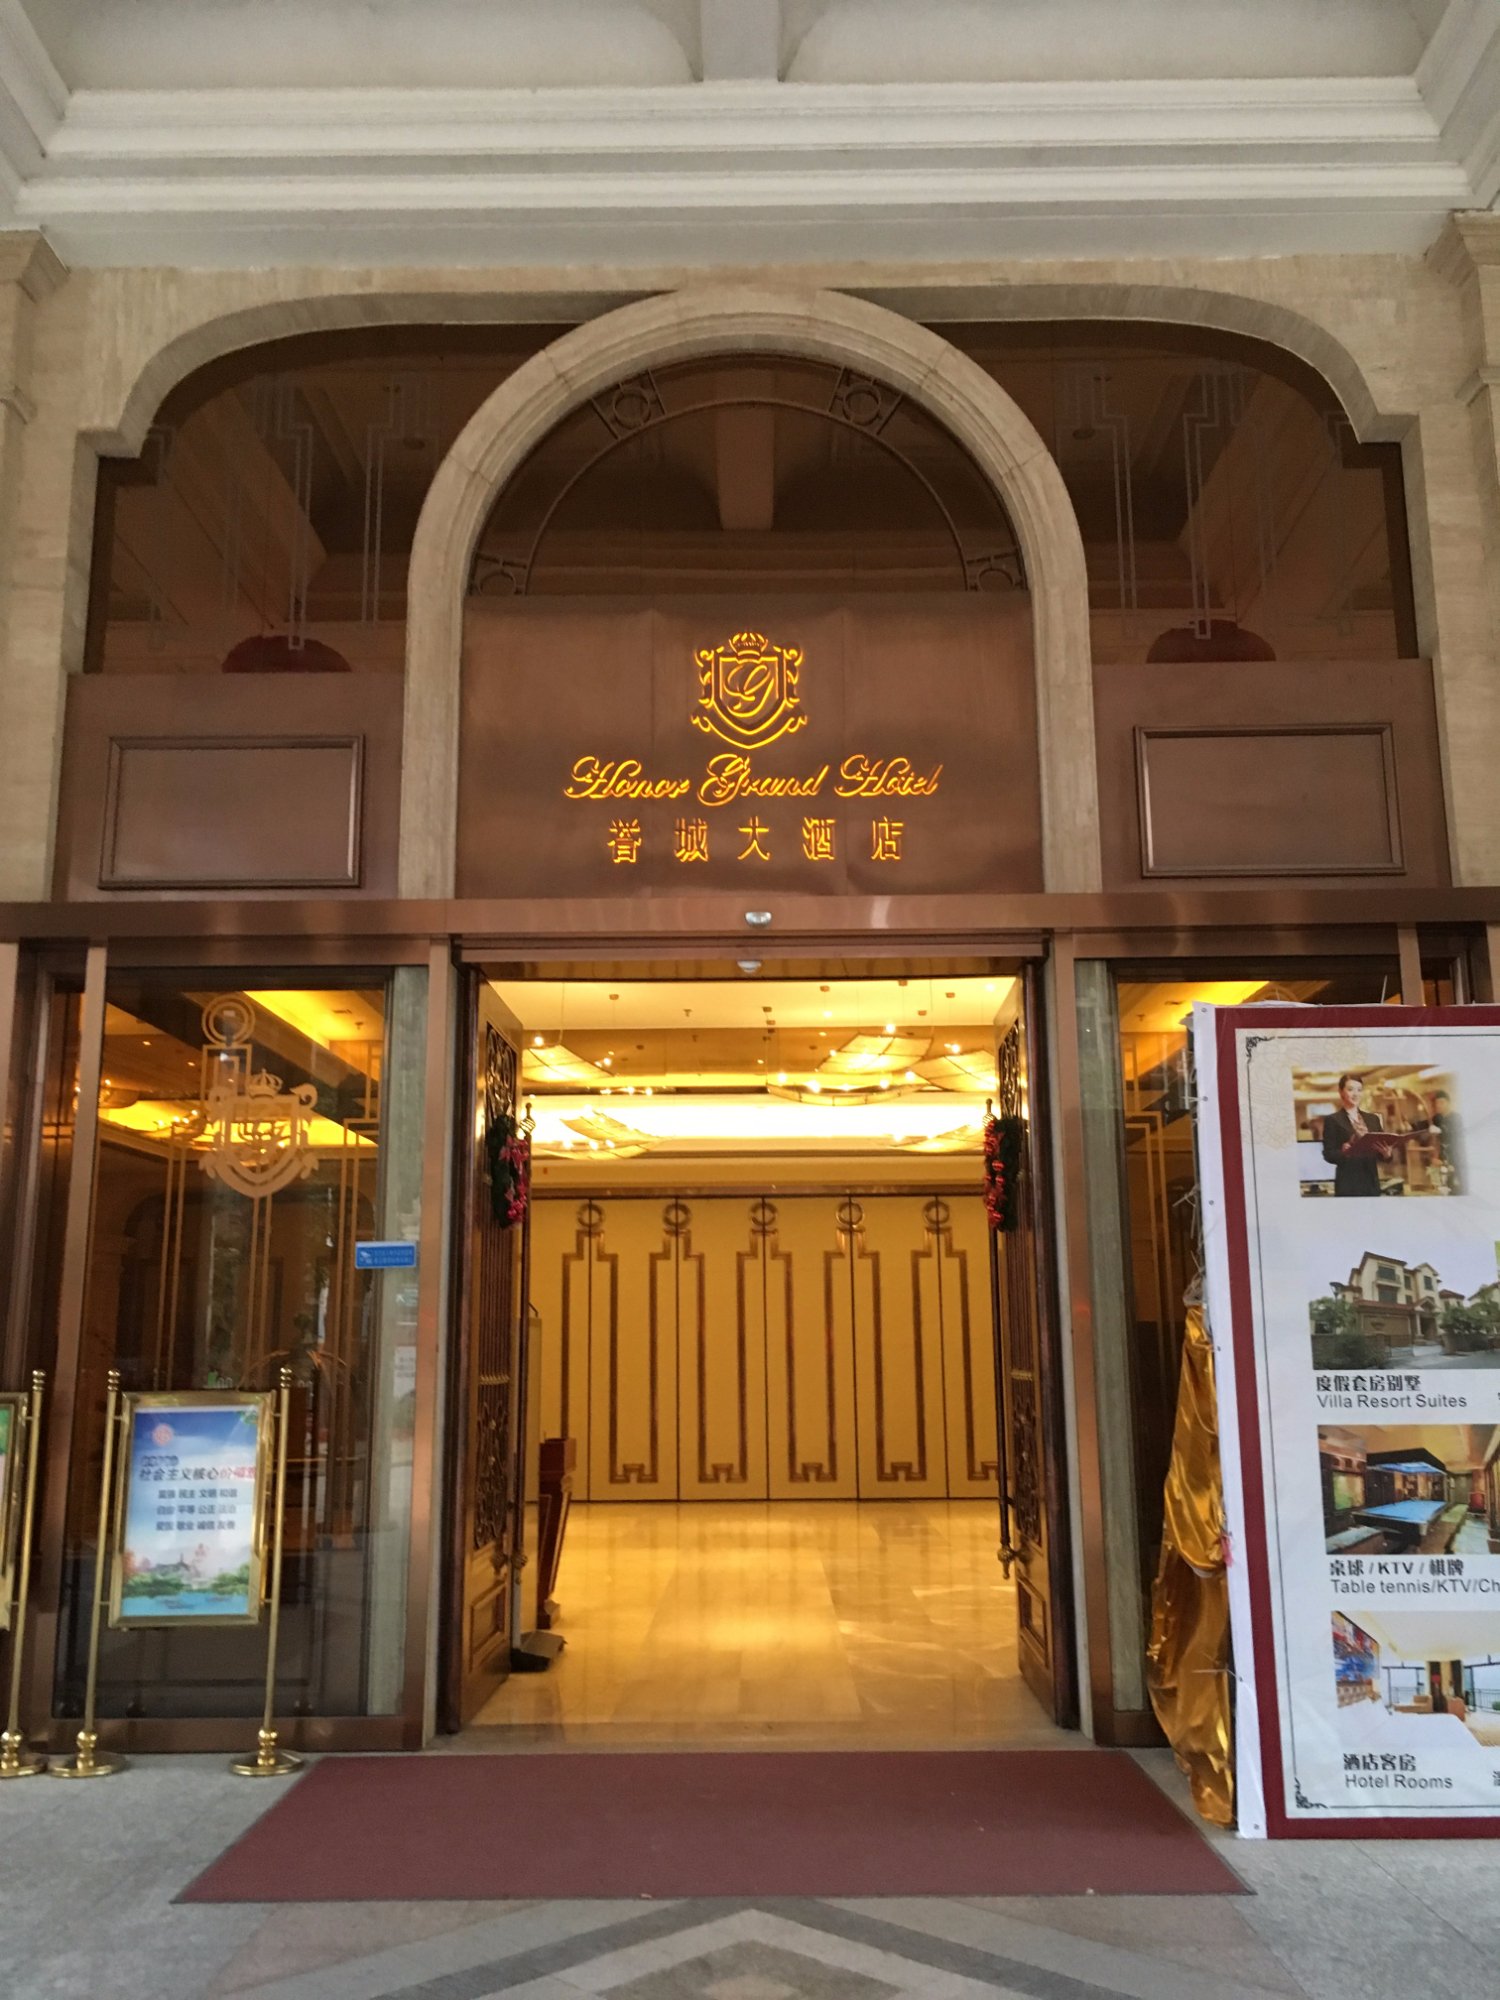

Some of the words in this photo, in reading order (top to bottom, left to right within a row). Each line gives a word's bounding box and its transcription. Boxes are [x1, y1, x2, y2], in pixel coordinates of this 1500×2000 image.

[563, 755, 690, 799] Honor
[697, 753, 831, 806] Grand
[834, 754, 944, 797] Hotel
[607, 816, 904, 863] 誉城大酒店
[1316, 1374, 1421, 1392] 度假套房别墅
[1316, 1394, 1353, 1408] Villa
[1357, 1394, 1412, 1408] Resort
[1416, 1393, 1467, 1408] Suites
[1330, 1559, 1364, 1576] 桌球
[1378, 1562, 1414, 1574] KTV
[1429, 1559, 1464, 1576] 棋牌
[1330, 1579, 1375, 1593] Table
[1343, 1753, 1416, 1772] 酒店客房
[1345, 1774, 1389, 1788] Hotel
[1394, 1774, 1453, 1789] Rooms
